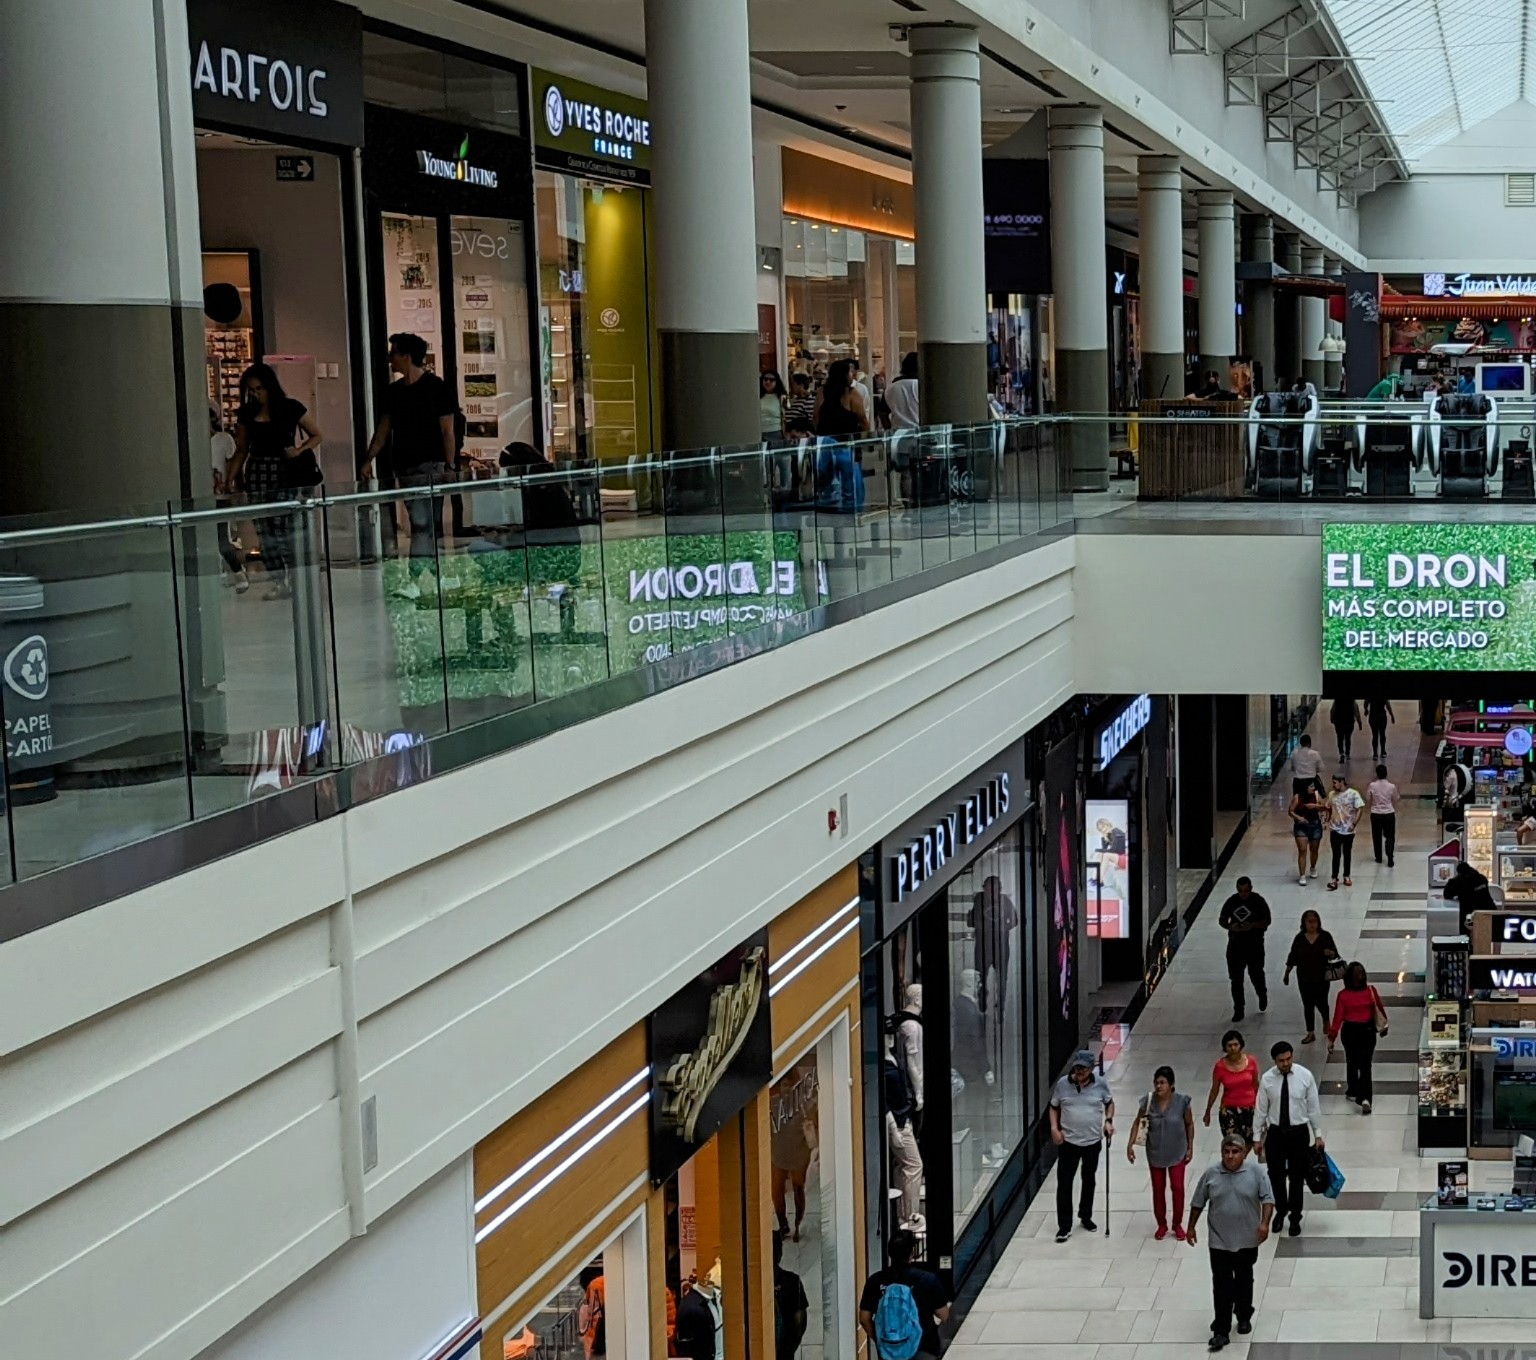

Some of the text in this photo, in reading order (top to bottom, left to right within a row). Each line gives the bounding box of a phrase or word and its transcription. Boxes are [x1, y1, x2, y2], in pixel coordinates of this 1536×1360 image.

[191, 40, 328, 117] ARFOIS
[565, 99, 650, 146] YVES ROCHE
[594, 138, 632, 159] FRANCE
[1449, 273, 1495, 295] Juan
[1327, 553, 1506, 588] EL DRON
[1328, 596, 1506, 618] MÁS COMPLETO
[1345, 630, 1488, 649] DEL MERCADO
[1100, 693, 1151, 772] SKECHERS
[895, 772, 1010, 903] PERRY ELLIS
